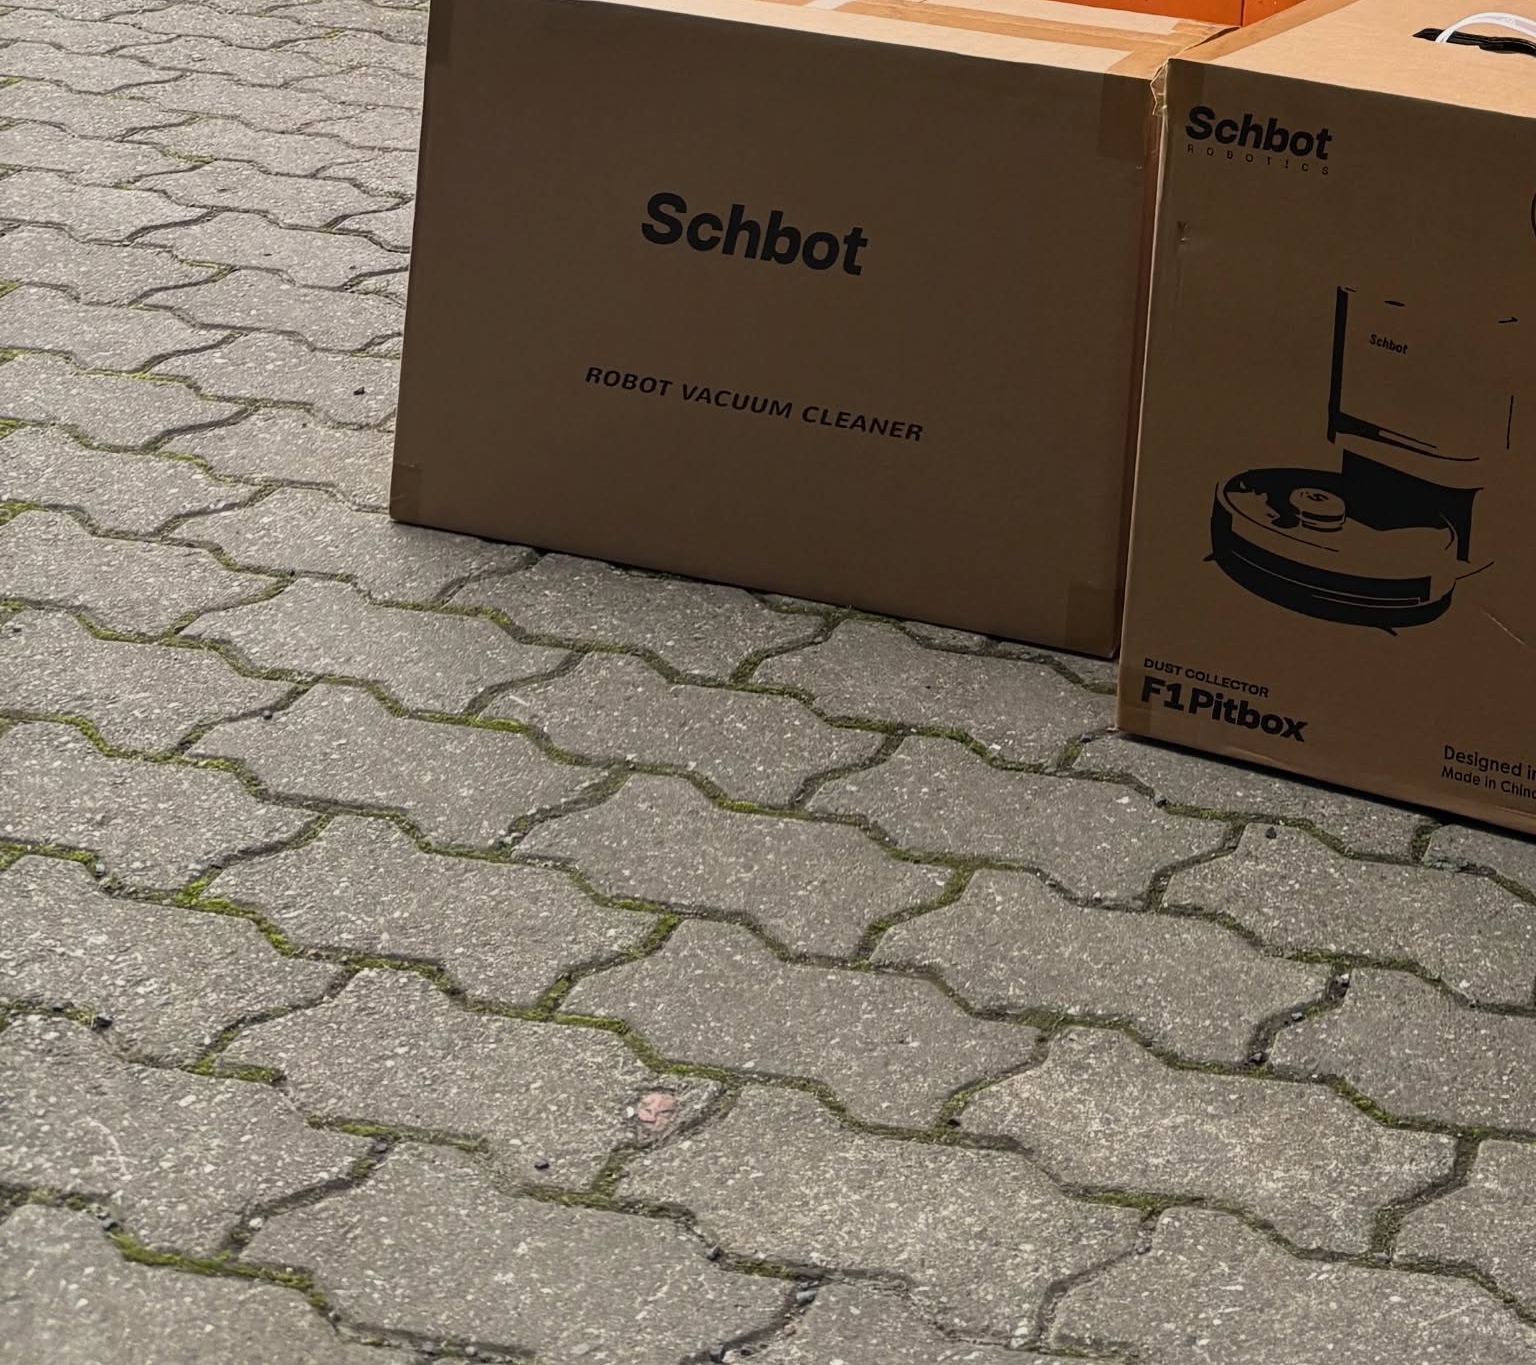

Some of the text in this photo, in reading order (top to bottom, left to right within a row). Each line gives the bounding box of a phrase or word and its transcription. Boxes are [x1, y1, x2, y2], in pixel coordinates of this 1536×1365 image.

[1186, 105, 1333, 160] Schbot
[1187, 144, 1330, 176] ROBOTICS
[640, 191, 869, 278] Schbot
[1369, 333, 1409, 355] Schbot
[585, 367, 924, 442] ROBOT VACUUM CLEANER
[1143, 657, 1270, 699] DUST COLLECTOR
[1441, 765, 1481, 788] Made
[1484, 773, 1497, 790] in
[1443, 744, 1524, 780] Designed
